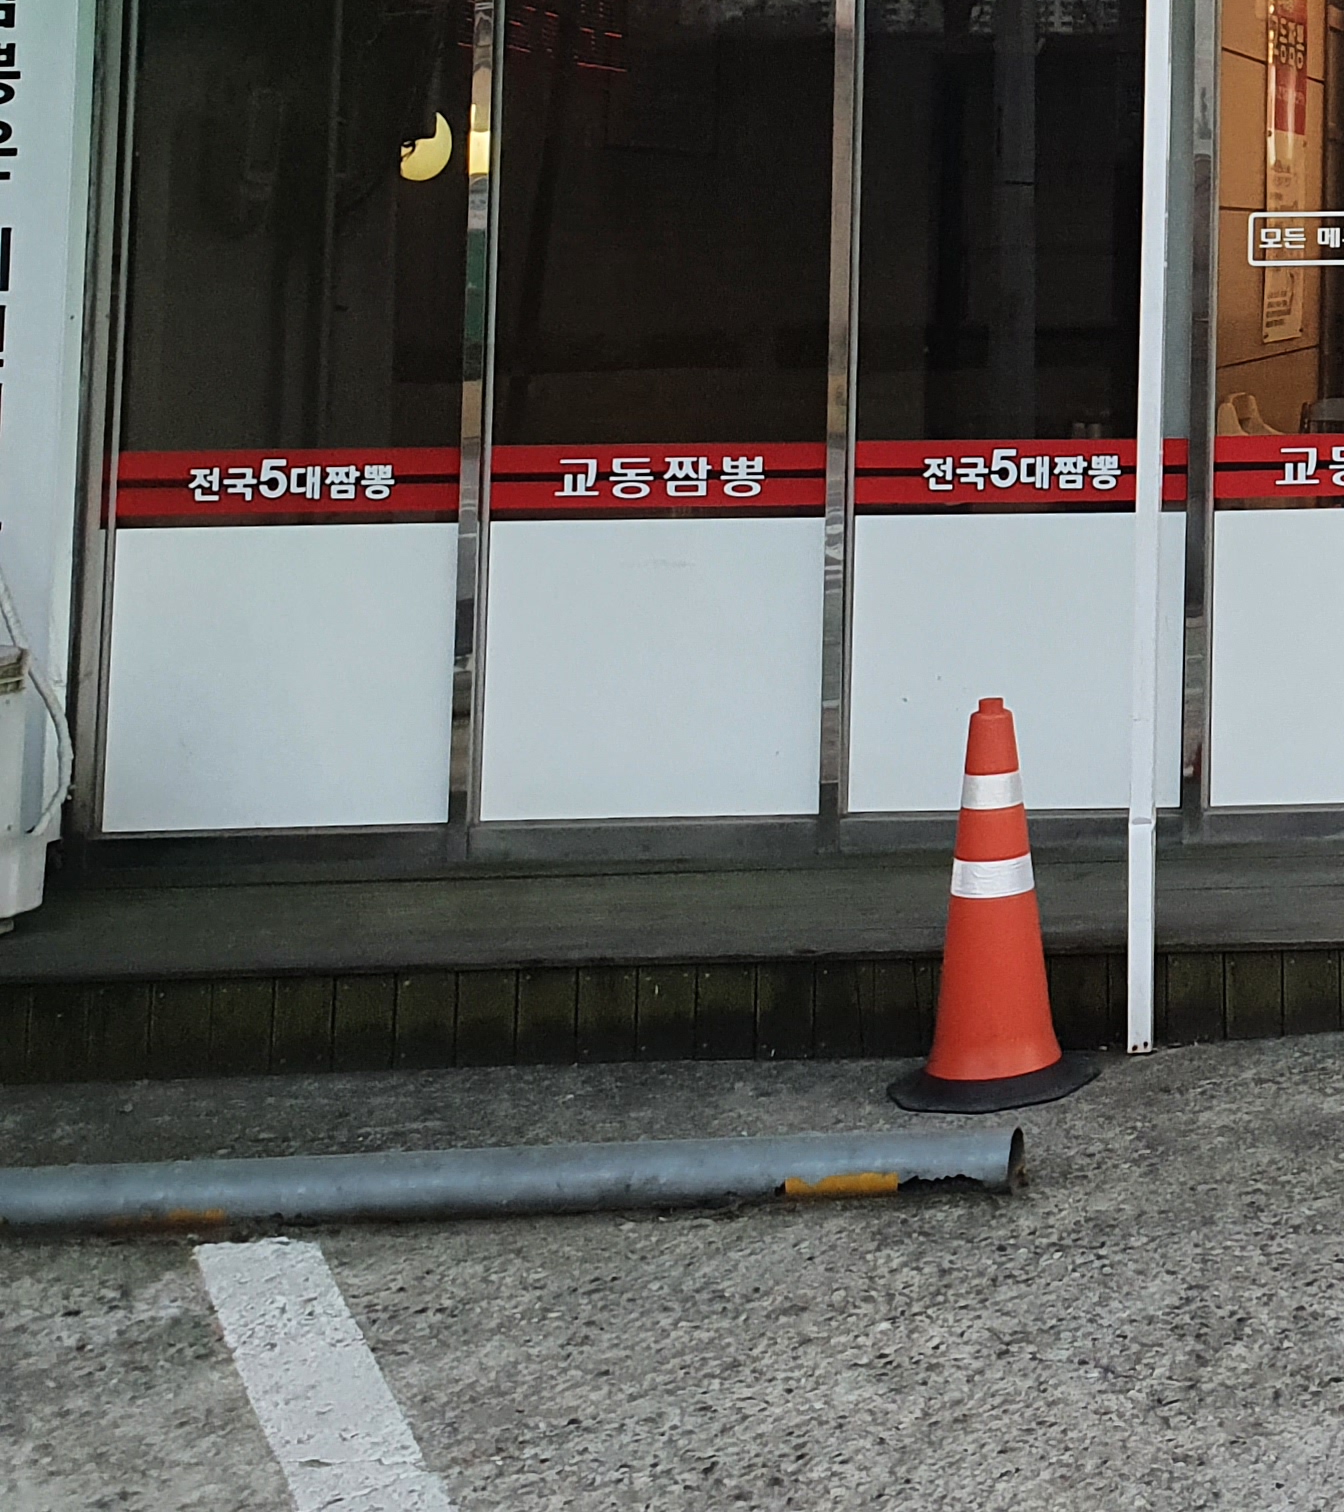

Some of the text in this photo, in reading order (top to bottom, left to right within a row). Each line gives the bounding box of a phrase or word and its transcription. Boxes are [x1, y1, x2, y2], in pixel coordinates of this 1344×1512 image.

[1258, 227, 1307, 249] 모든
[188, 458, 396, 502] 전국5대짬뽕
[554, 456, 768, 500] 교동짬뽕
[922, 448, 1122, 491] 전국5대짬뽕
